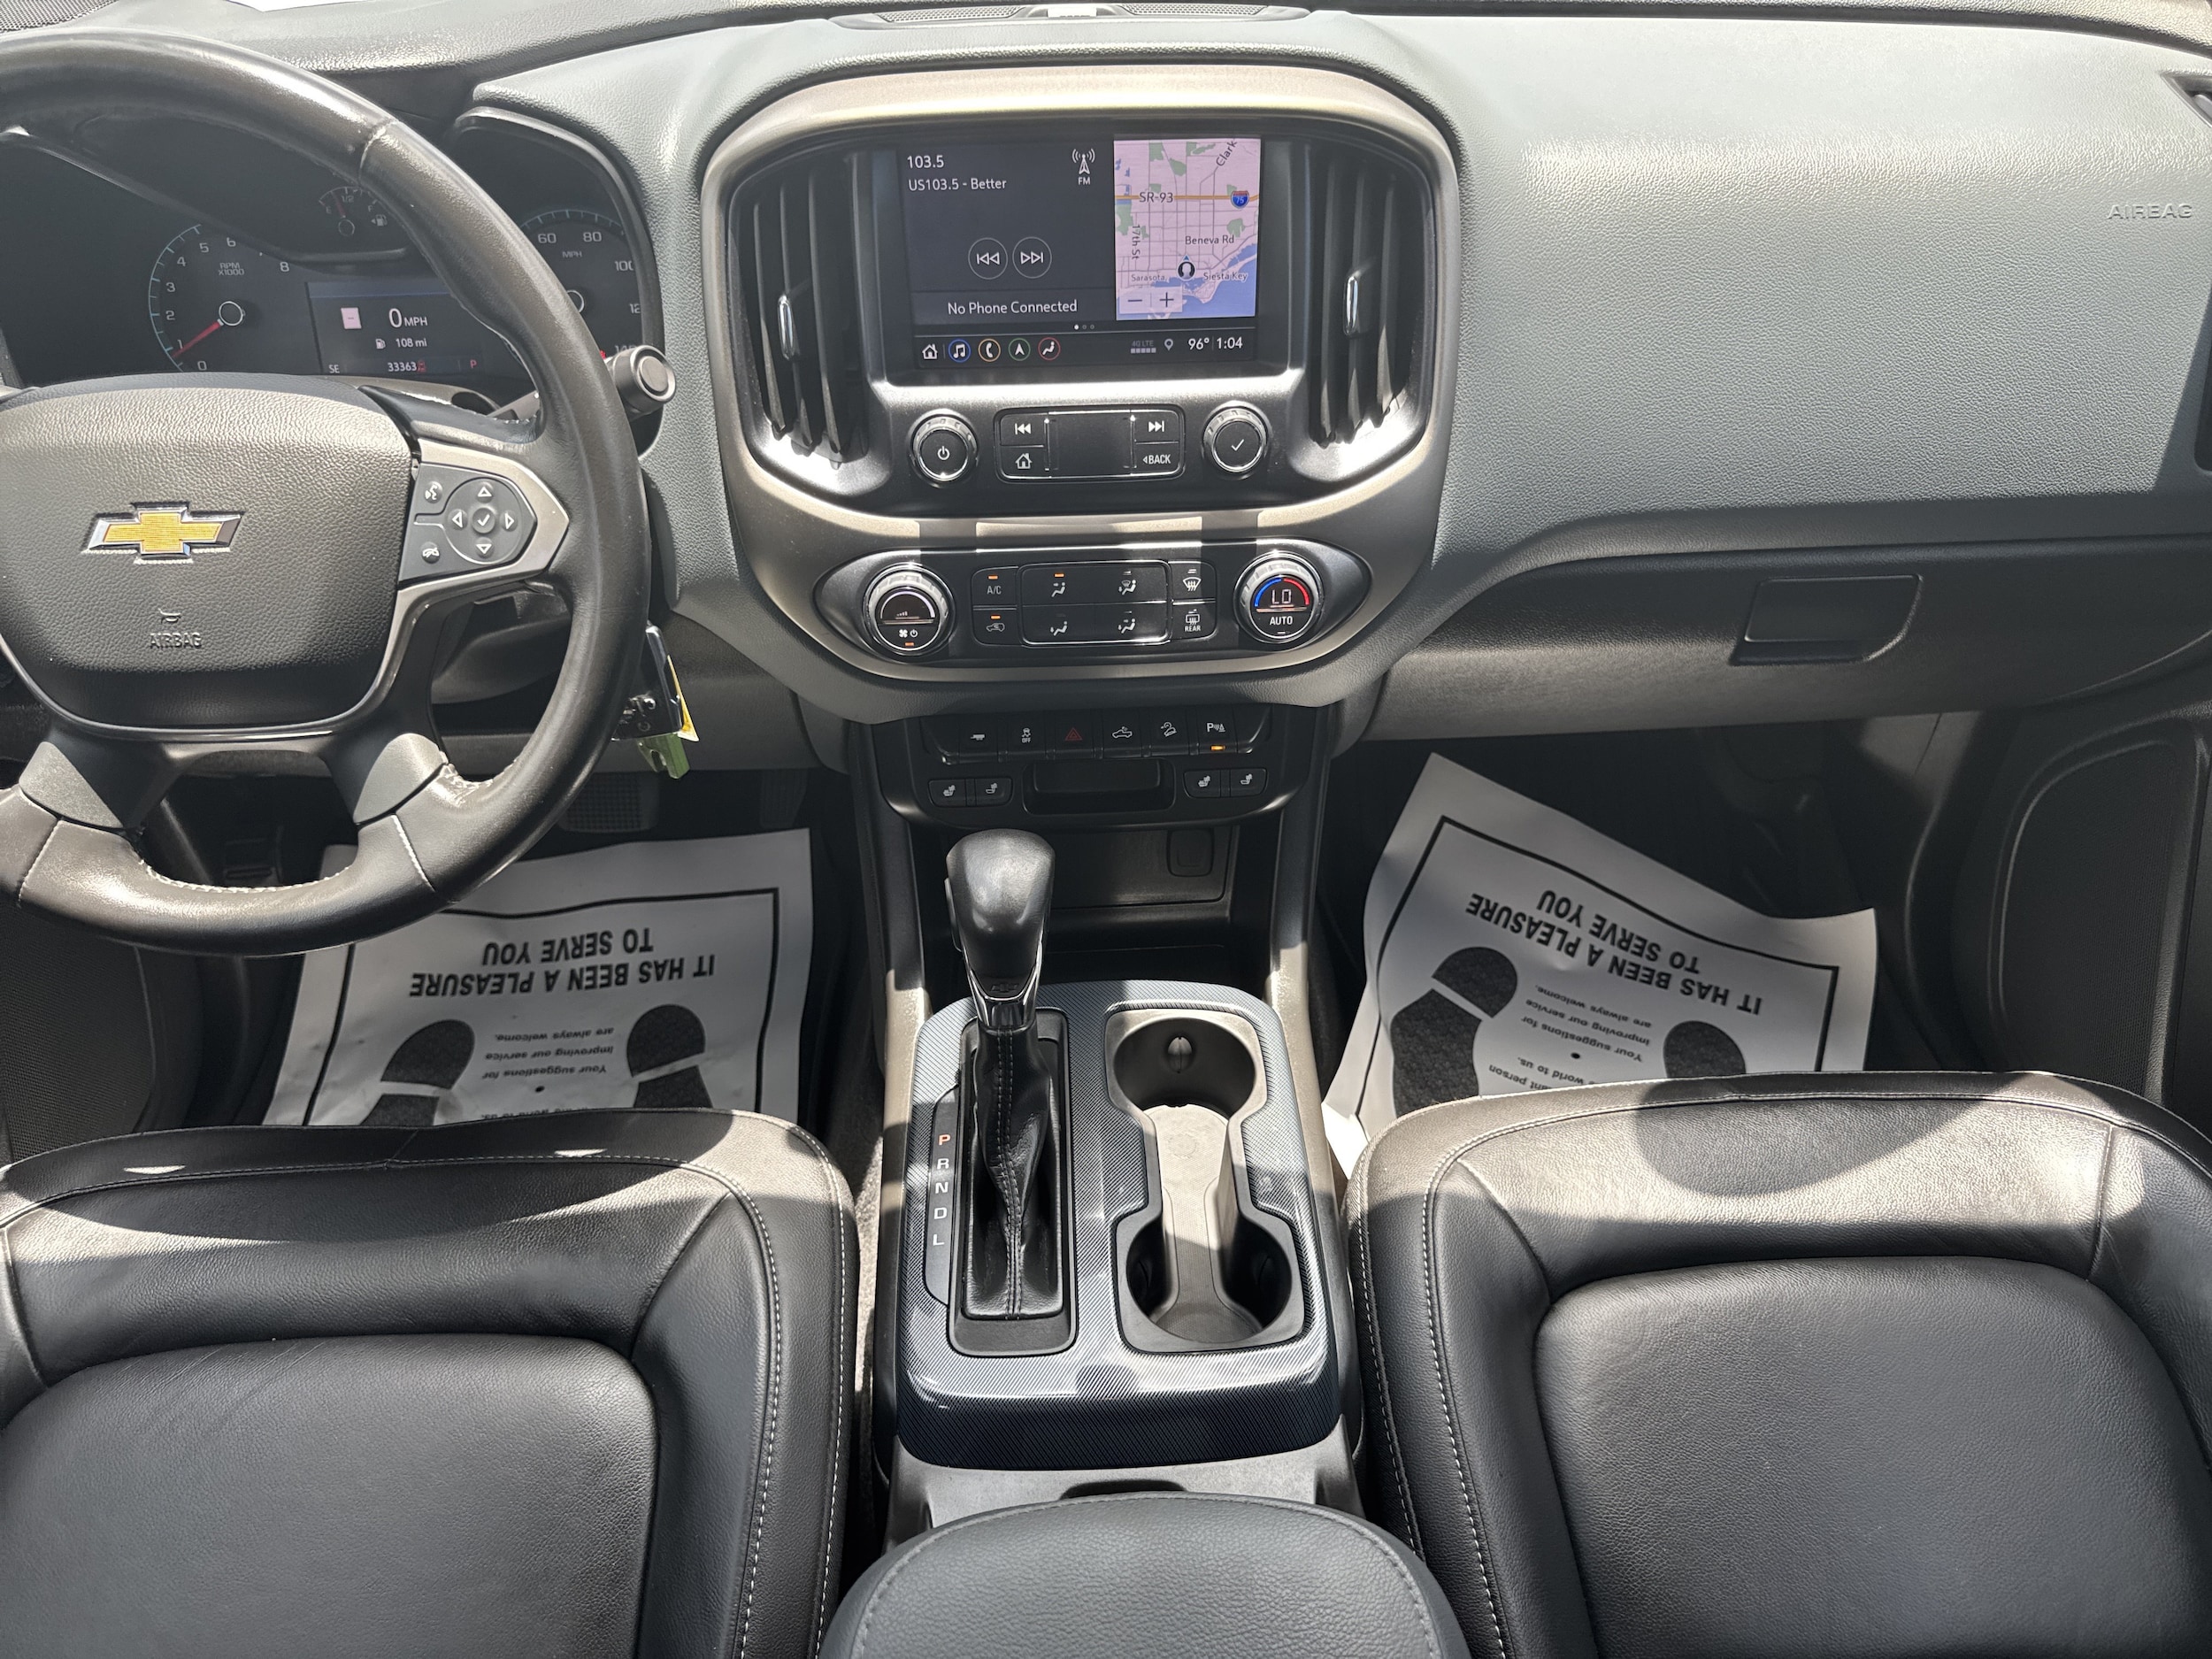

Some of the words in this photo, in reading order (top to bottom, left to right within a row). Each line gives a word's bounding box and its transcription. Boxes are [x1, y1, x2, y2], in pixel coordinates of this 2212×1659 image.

[1216, 139, 1238, 167] Clark
[907, 155, 944, 169] 103.5
[908, 178, 959, 191] US103.5
[971, 177, 1007, 190] Better
[1078, 177, 1091, 186] FM
[1139, 191, 1173, 204] SR-93
[2107, 204, 2193, 219] AIRBAG
[538, 233, 557, 243] 60
[583, 232, 602, 242] 80
[1132, 224, 1141, 246] 17th
[1185, 235, 1219, 245] Beneva
[1223, 234, 1234, 244] Rd
[199, 242, 209, 253] 5
[227, 237, 236, 247] 6
[1132, 249, 1141, 259] St
[177, 257, 187, 266] 4
[280, 262, 289, 273] 8
[1203, 272, 1229, 280] Siesta
[1232, 272, 1248, 282] Key
[166, 281, 175, 292] 3
[948, 302, 966, 315] No
[969, 301, 1008, 315] Phone
[1010, 299, 1078, 314] Connected
[165, 310, 175, 320] 2
[388, 307, 403, 328] 0
[404, 317, 427, 327] MPH
[177, 340, 183, 349] 1
[396, 338, 413, 348] 108
[416, 338, 427, 347] mi
[1187, 337, 1210, 350] 96°
[1217, 337, 1243, 349] 1:04
[197, 360, 207, 371] 0
[329, 365, 340, 374] SE
[388, 361, 417, 372] 33363
[470, 359, 477, 368] P
[1148, 454, 1171, 465] BACK
[987, 585, 1002, 595] A/C
[1270, 616, 1293, 626] AUTO
[150, 632, 202, 649] AIRBAG
[1536, 890, 1584, 928] YOU
[1465, 893, 1582, 958] PLEASURE
[623, 927, 654, 954] TO
[1588, 913, 1662, 962] SERVE
[541, 930, 614, 963] SERVE
[482, 941, 531, 966] YOU
[1587, 943, 1604, 967] A
[693, 954, 716, 978] IT
[1669, 950, 1701, 975] TO
[639, 956, 685, 984] HAS
[1607, 954, 1672, 991] BEEN
[544, 969, 561, 993] A
[567, 963, 629, 991] BEEN
[410, 971, 535, 997] PLEASURE
[1535, 985, 1586, 1009] welcome.
[1679, 978, 1730, 1007] HAS
[1525, 998, 1565, 1019] service
[1736, 993, 1762, 1016] IT
[1589, 1004, 1628, 1023] always
[1521, 1015, 1538, 1029] for
[1568, 1015, 1588, 1027] our
[1632, 1018, 1652, 1028] are
[1541, 1023, 1611, 1051] suggestions
[1592, 1021, 1650, 1046] improving
[486, 1051, 527, 1062] service
[531, 1049, 551, 1059] our
[1614, 1047, 1643, 1063] Your
[579, 1064, 607, 1075] Your
[1517, 1056, 1534, 1070] us.
[1488, 1064, 1528, 1086] person
[1537, 1064, 1549, 1076] to
[1551, 1069, 1584, 1086] world
[939, 1133, 950, 1146] P
[937, 1157, 949, 1170] R
[935, 1182, 949, 1194] N
[933, 1207, 948, 1219] D
[933, 1233, 945, 1246] L
